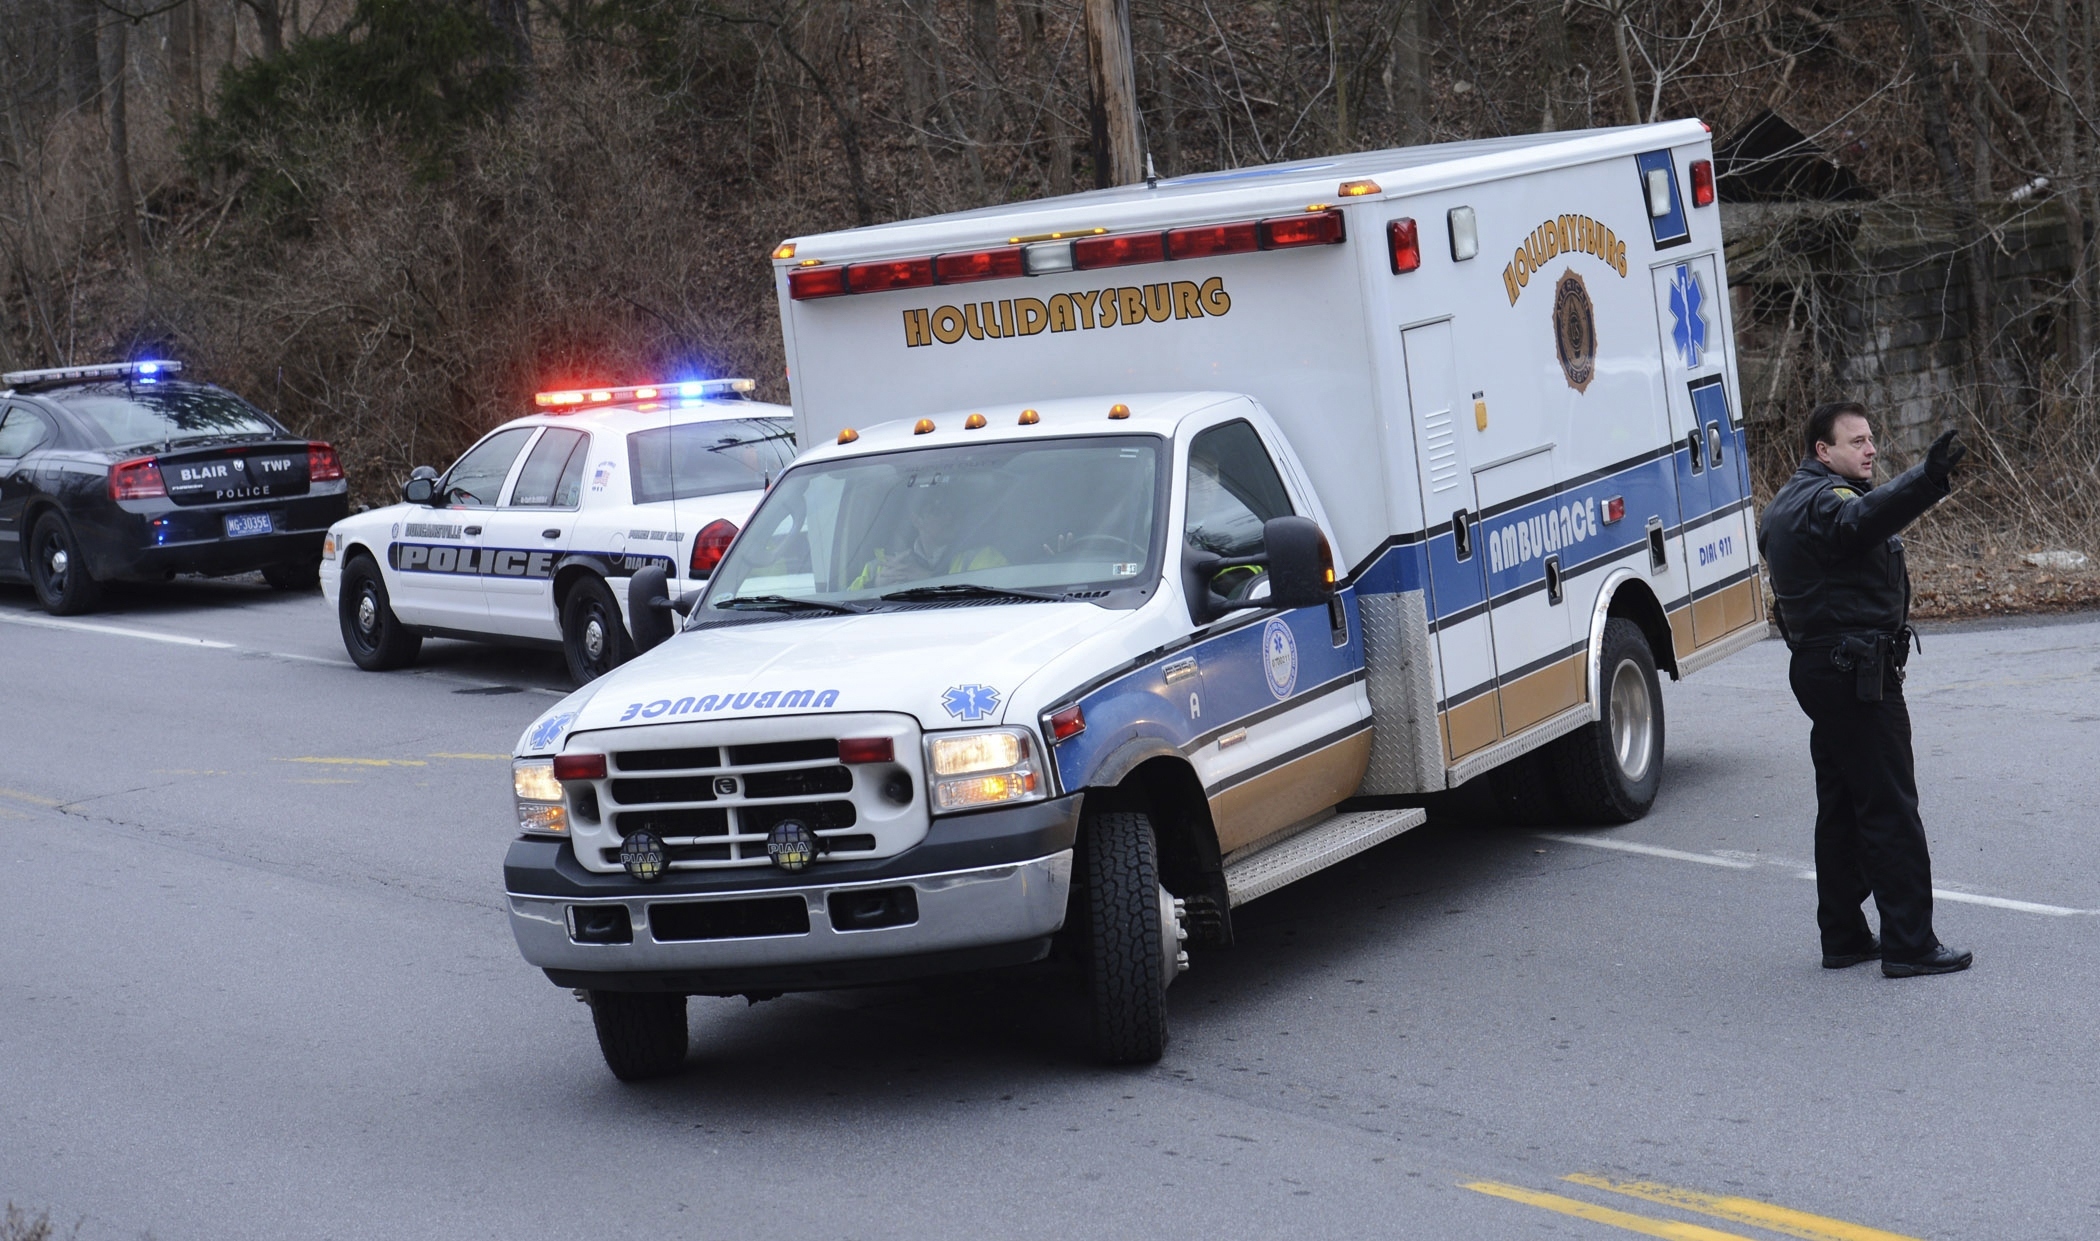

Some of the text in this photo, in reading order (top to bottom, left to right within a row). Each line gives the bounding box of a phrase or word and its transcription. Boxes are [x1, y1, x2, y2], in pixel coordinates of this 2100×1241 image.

[1502, 213, 1627, 308] HOLLIDAYSBURG
[903, 276, 1231, 348] HOLLIDAYSBURG
[1566, 356, 1592, 382] LEGION
[180, 459, 291, 481] BLAIR TWP
[216, 485, 270, 499] POLICE
[1489, 497, 1597, 574] AMBULANCE
[400, 545, 553, 577] POLICE
[1699, 536, 1732, 566] DIAL 911
[1189, 692, 1200, 720] A
[620, 852, 659, 863] PIAA
[767, 842, 808, 854] PIAA
